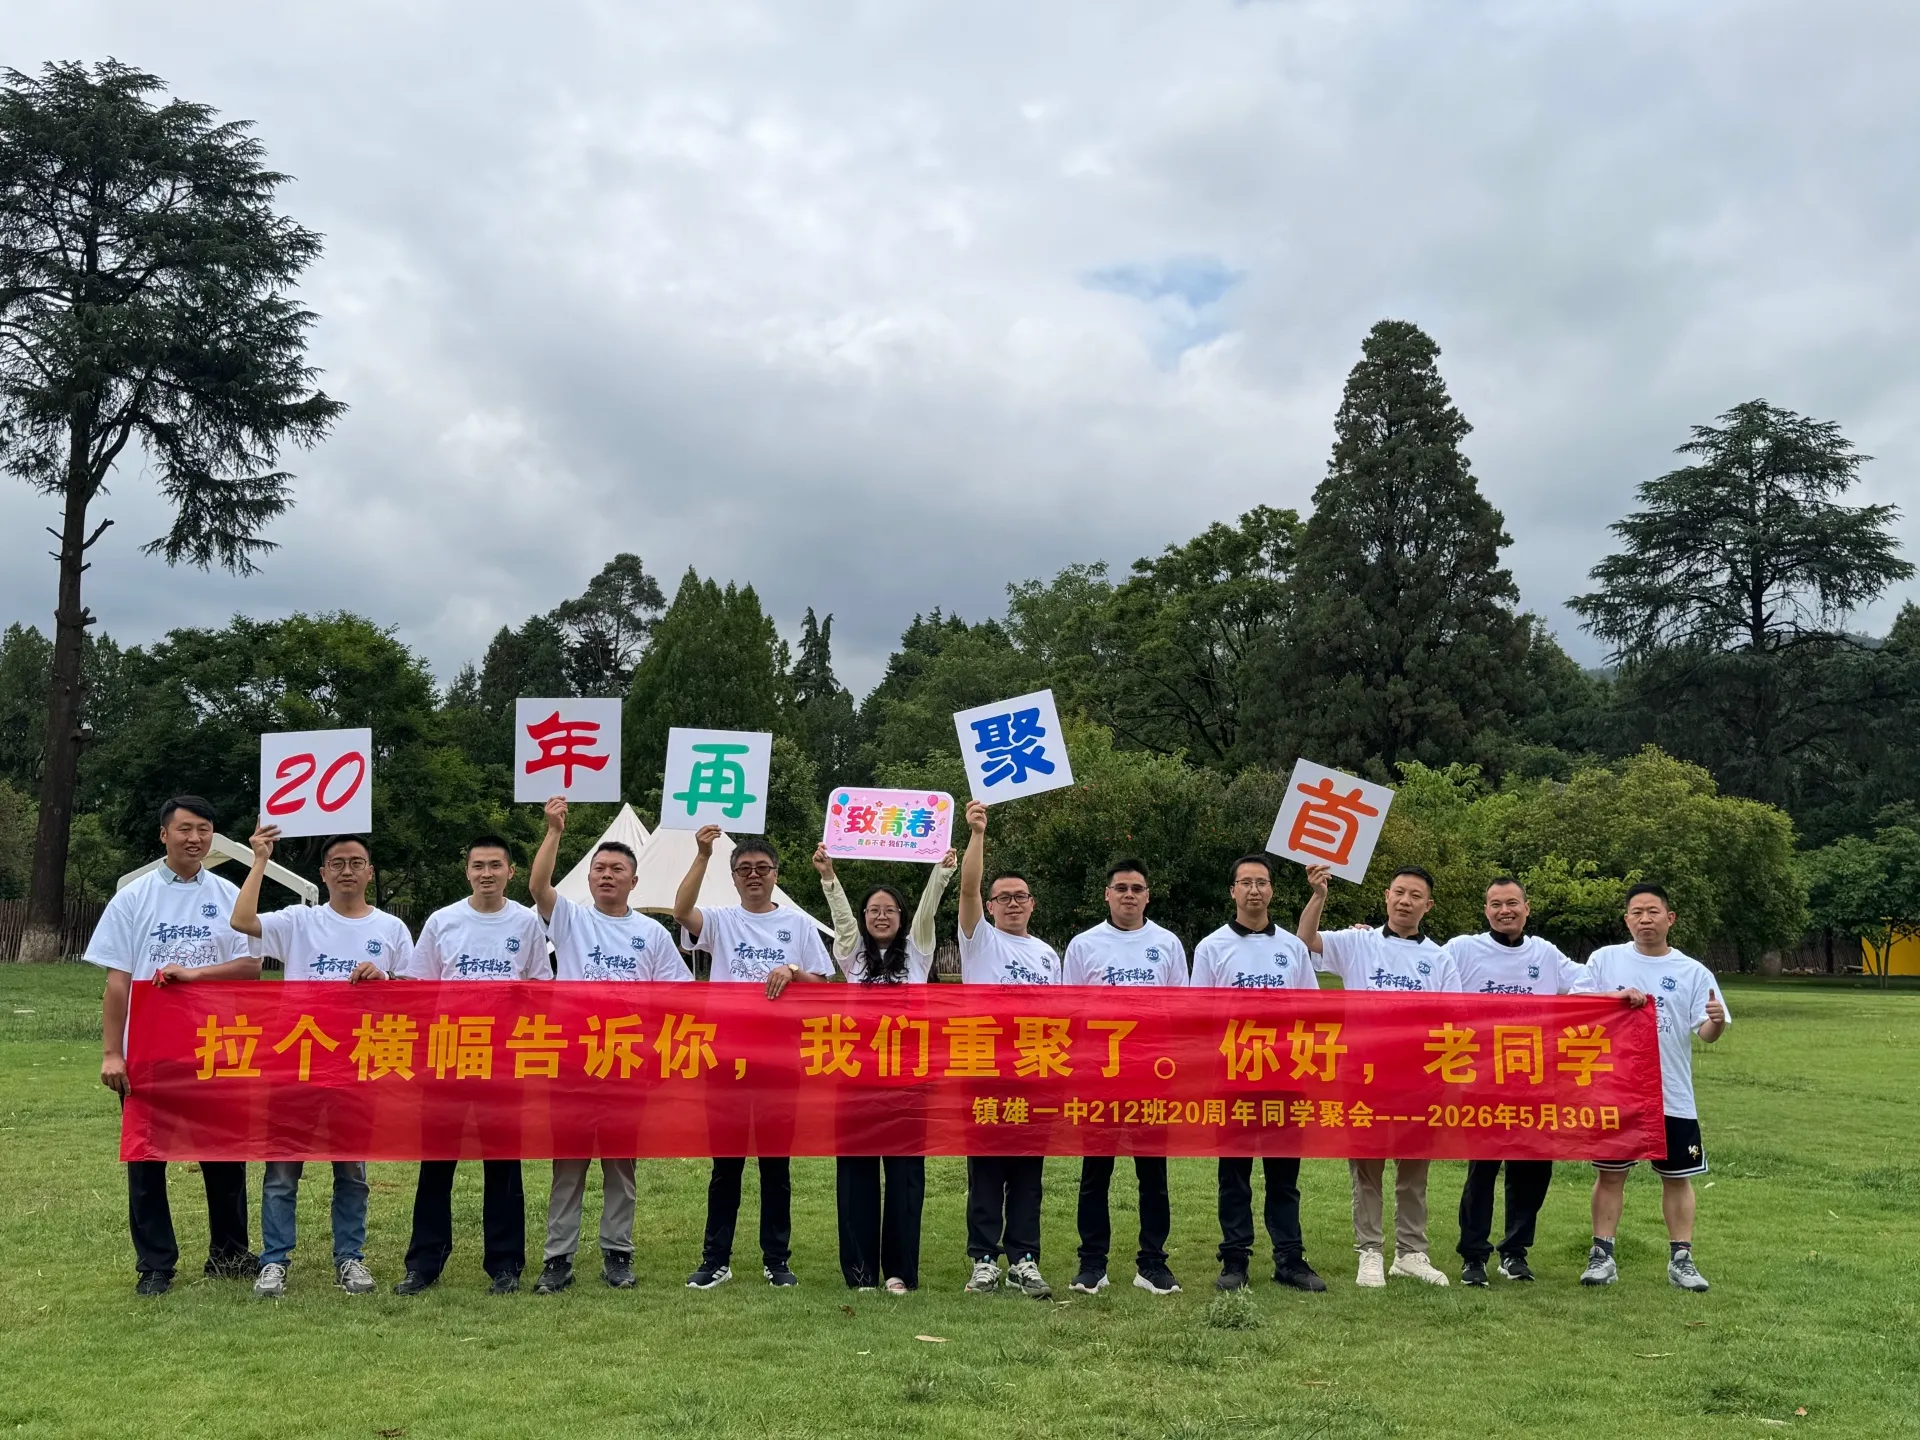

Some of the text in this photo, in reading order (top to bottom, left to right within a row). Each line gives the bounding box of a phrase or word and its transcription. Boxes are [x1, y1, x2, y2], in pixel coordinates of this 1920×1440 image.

[265, 751, 366, 816] 20
[525, 711, 610, 788] 年
[673, 744, 757, 818] 再
[971, 707, 1055, 788] 聚
[844, 805, 936, 838] 致青春
[1287, 778, 1379, 866] 首
[588, 945, 636, 970] 青不散场
[195, 1014, 1614, 1088] 拉个横幅告诉你，我们重聚了。你好，老同学
[972, 1097, 1620, 1131] 镇雄一中212班20周年同学聚会---2026年5月30日
